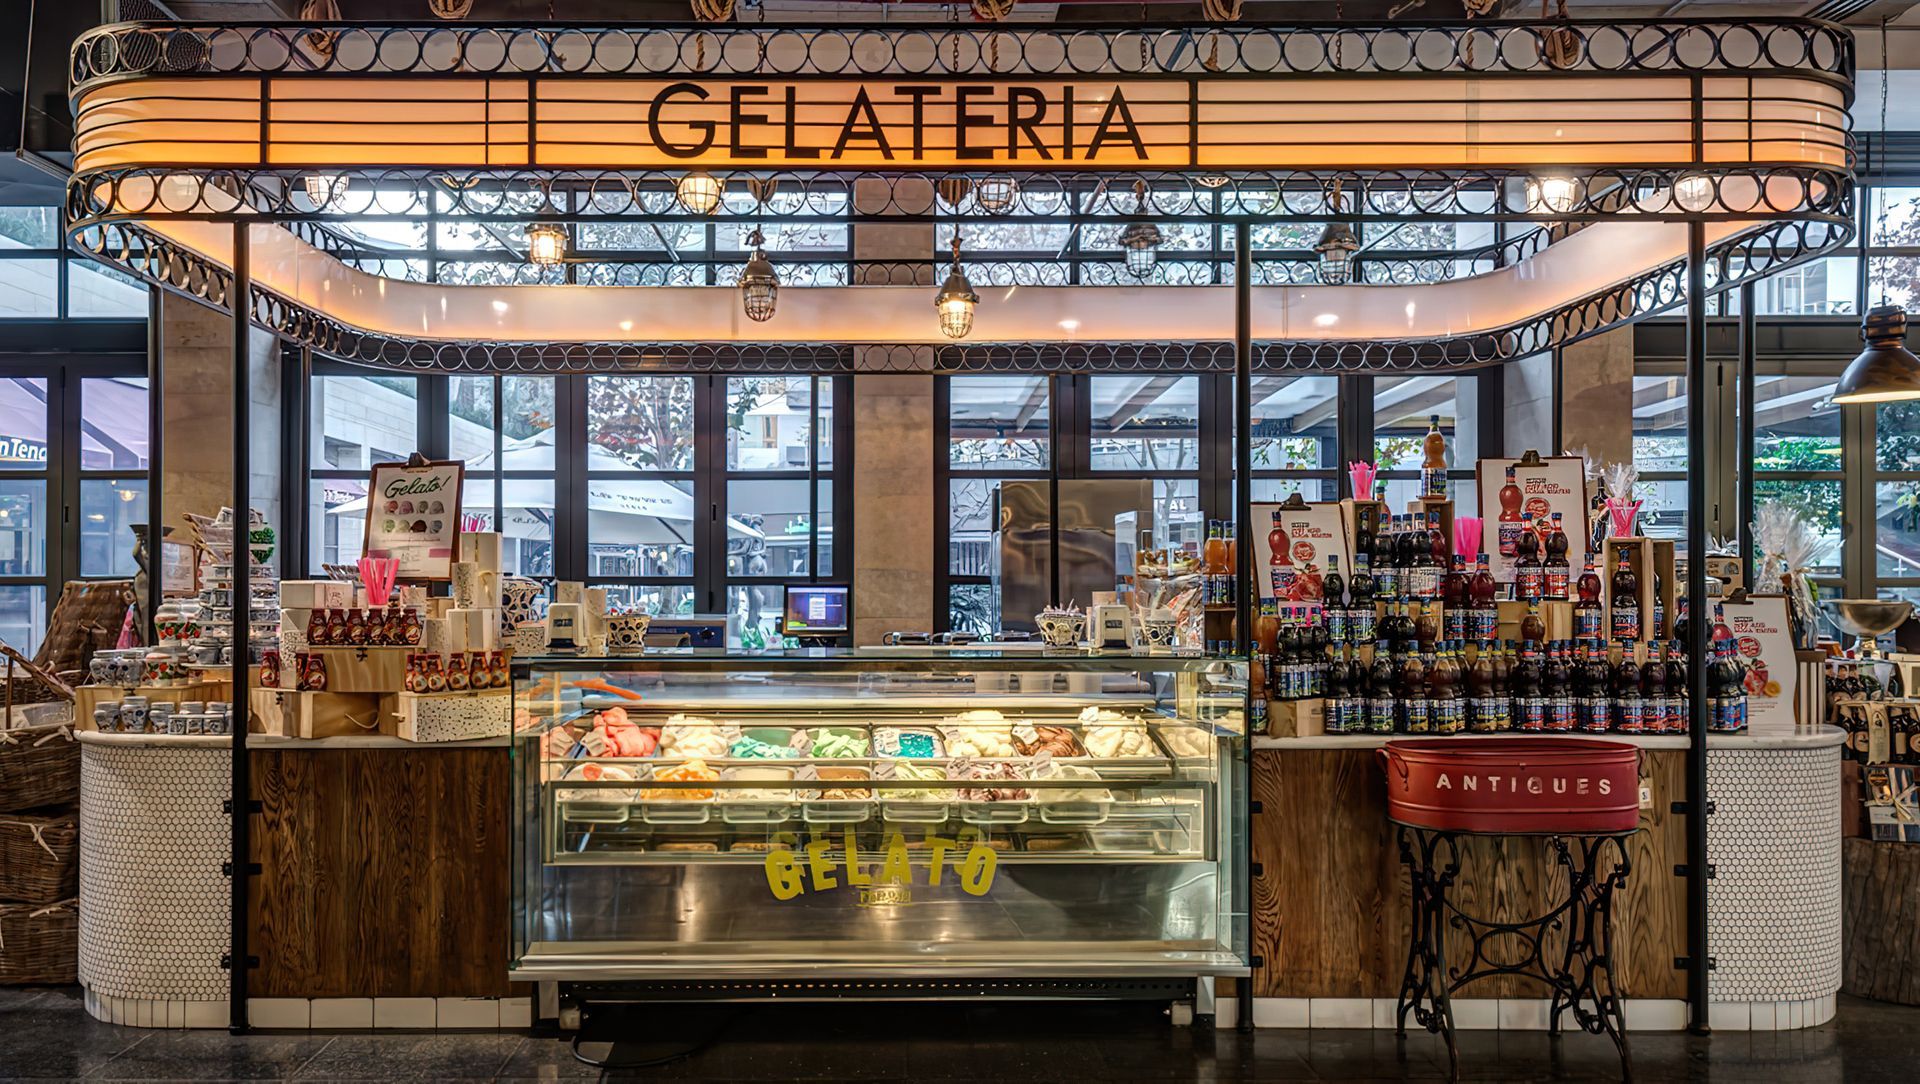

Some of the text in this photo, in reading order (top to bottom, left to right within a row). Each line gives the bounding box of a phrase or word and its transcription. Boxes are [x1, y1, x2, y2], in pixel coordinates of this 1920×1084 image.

[648, 82, 1149, 161] GELATERIA
[384, 475, 452, 499] Gelato!
[1436, 773, 1612, 795] ANTIQUES
[765, 832, 998, 901] GELATO
